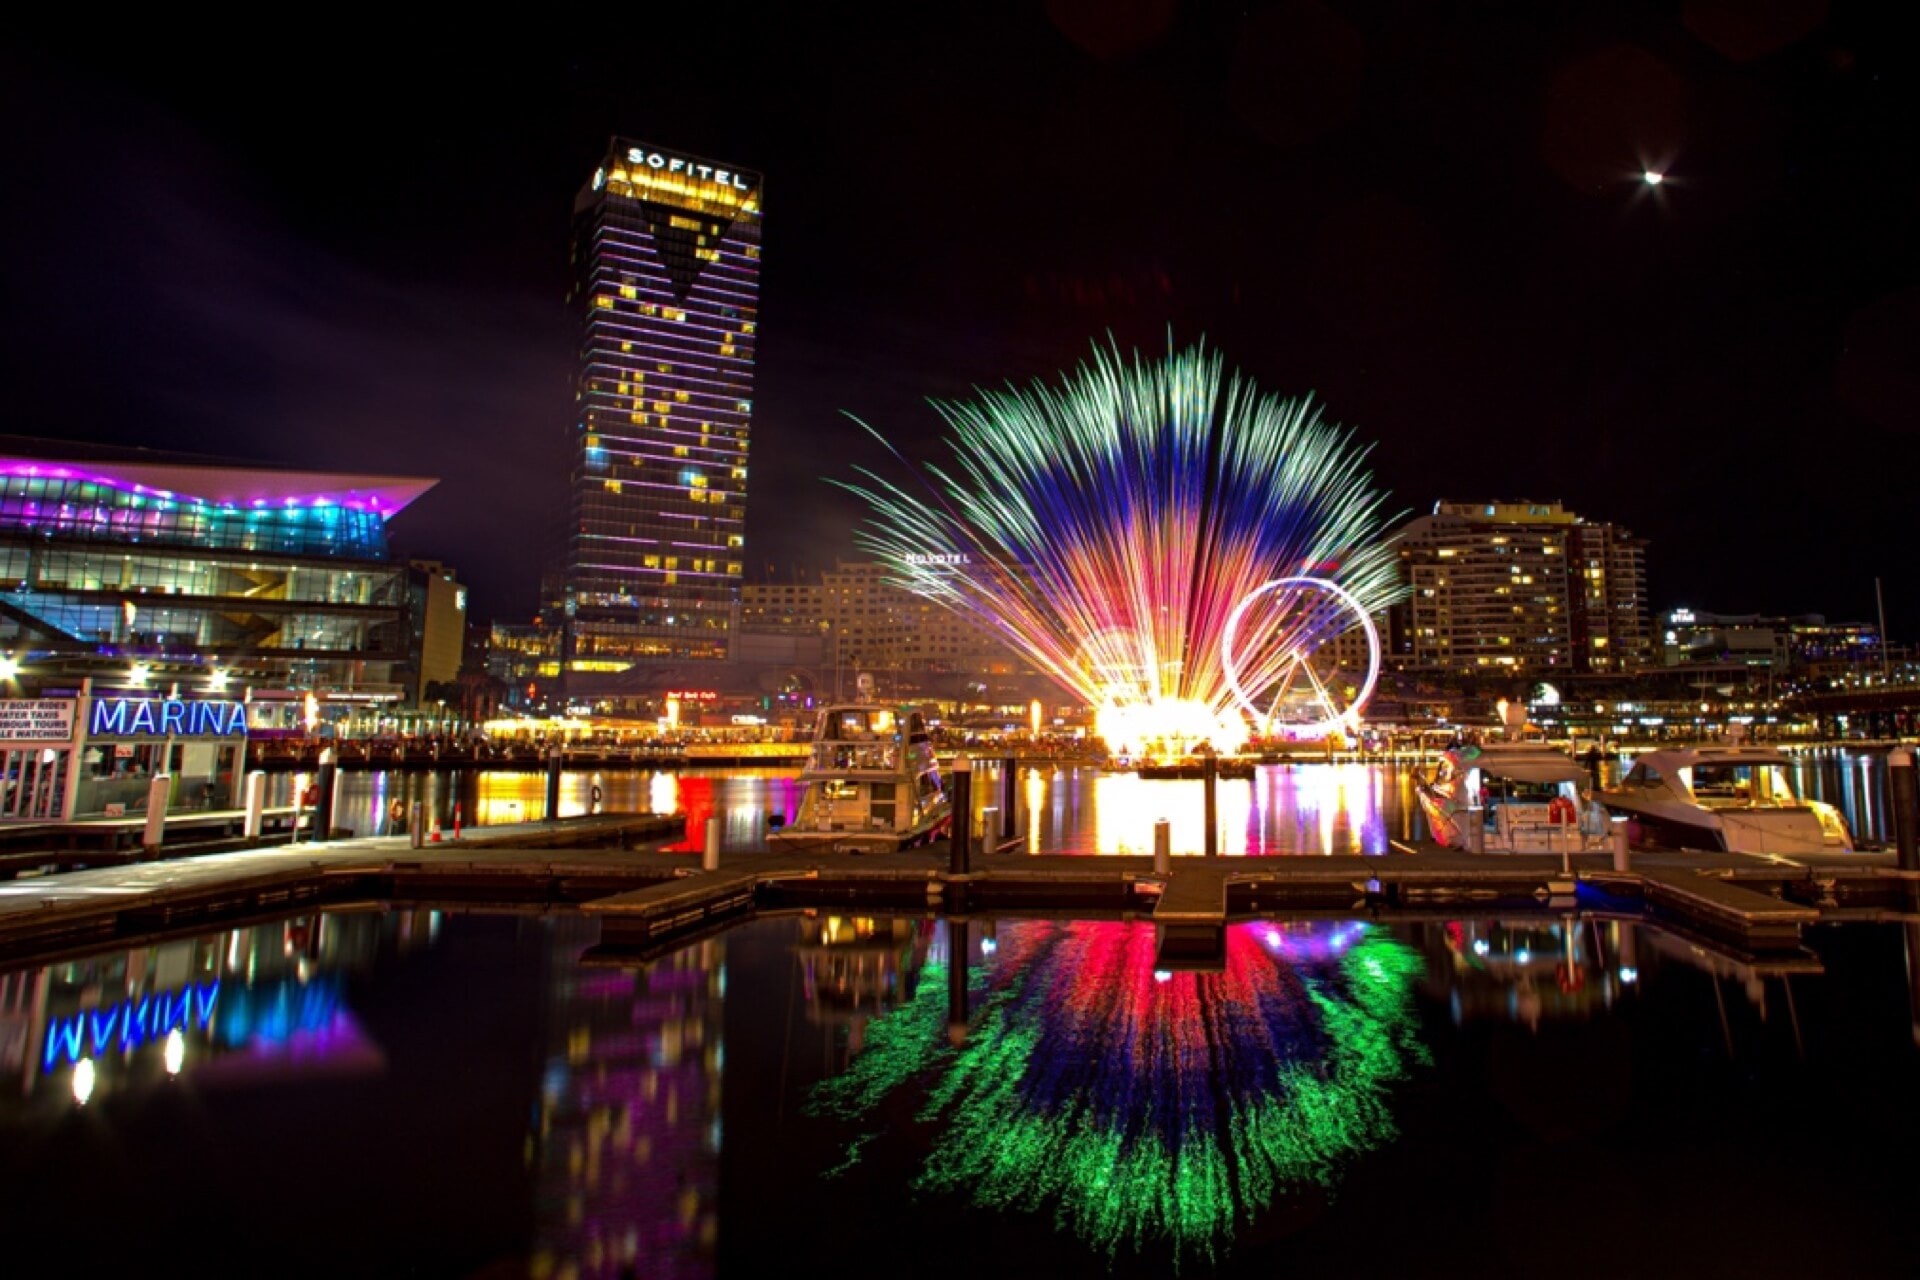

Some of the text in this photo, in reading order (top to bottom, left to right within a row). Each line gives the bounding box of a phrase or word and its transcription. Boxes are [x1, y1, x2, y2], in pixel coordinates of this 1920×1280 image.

[627, 147, 748, 191] SOFITEL
[905, 552, 972, 564] NOVOTEL
[9, 701, 35, 710] BOAT
[38, 701, 67, 710] RIDES
[31, 711, 59, 719] TAXIS
[91, 699, 249, 736] MARINA
[34, 720, 67, 728] TOURS
[16, 730, 69, 738] WATCHING
